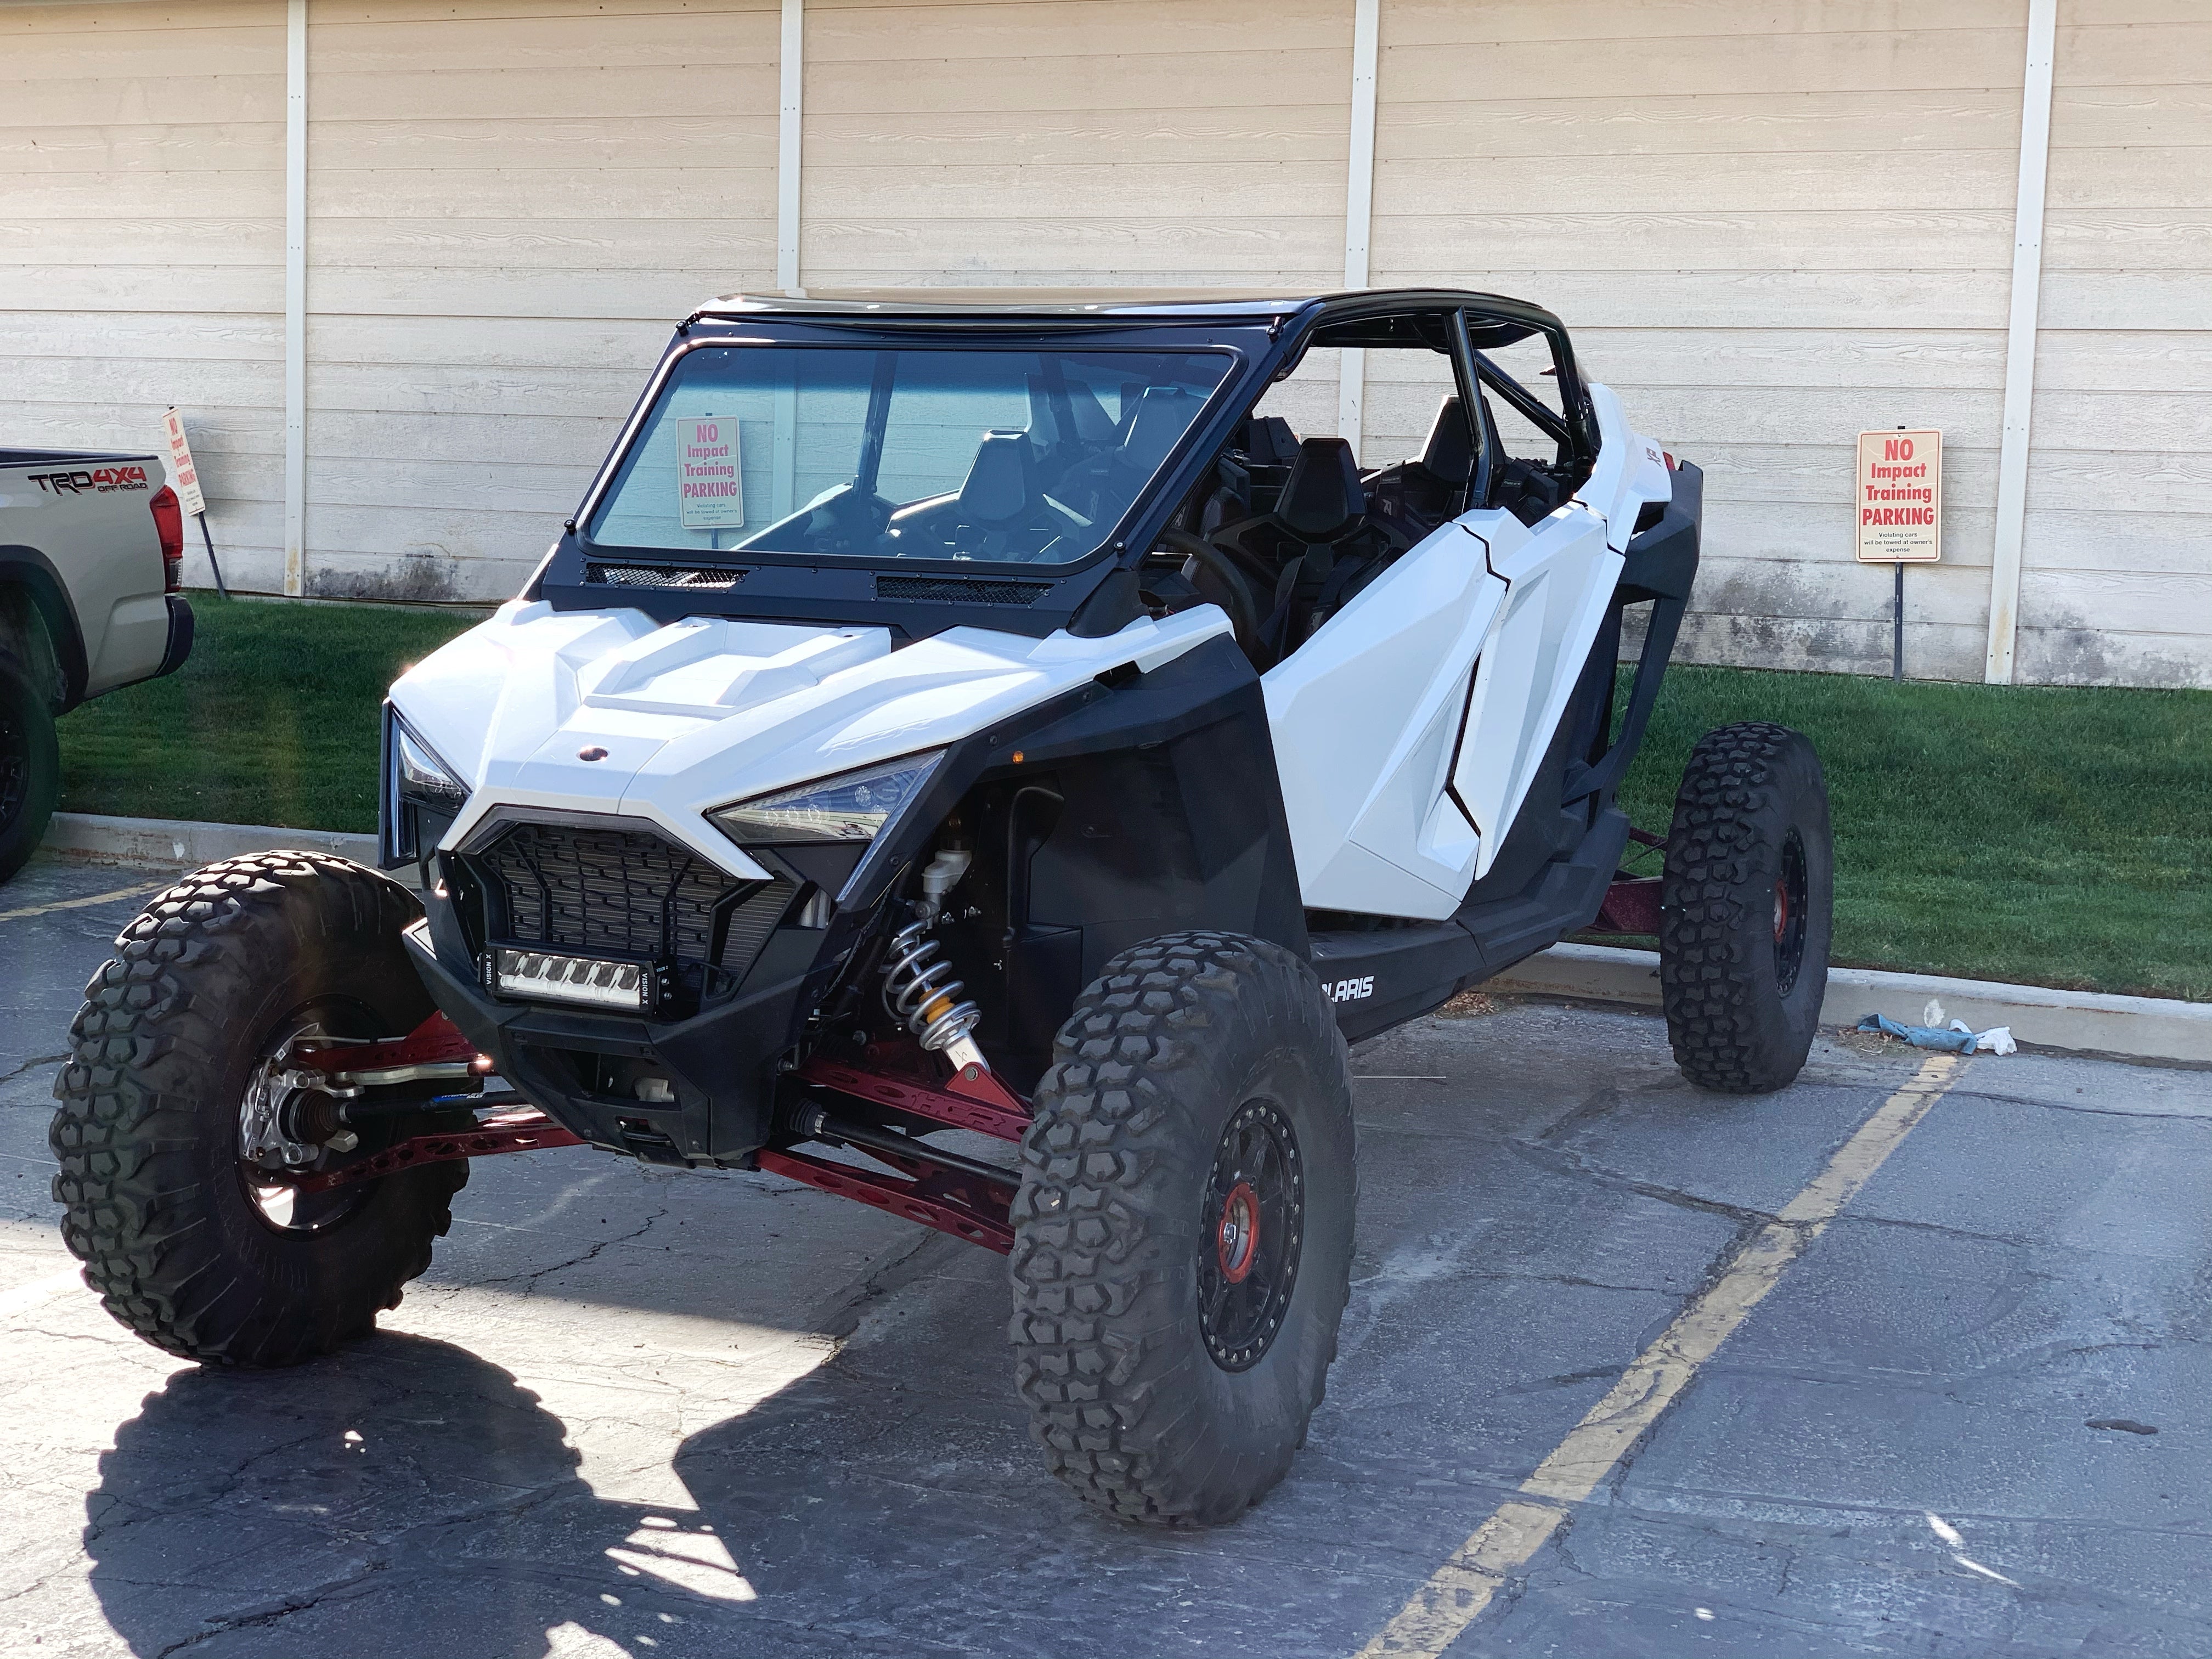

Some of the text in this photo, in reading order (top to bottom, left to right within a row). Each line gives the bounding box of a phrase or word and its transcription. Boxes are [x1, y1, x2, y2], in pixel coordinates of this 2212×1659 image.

[697, 424, 718, 443] NO
[687, 444, 729, 460] Impact
[1885, 439, 1914, 461] NO
[684, 461, 734, 478] Training
[1871, 462, 1927, 481] Impact
[27, 471, 95, 496] TRD
[97, 483, 148, 493] OFF ROAD
[684, 481, 737, 498] PARKING
[1866, 483, 1932, 503] Training
[1863, 507, 1934, 526] PARKING
[1322, 975, 1374, 1003] LARIS
